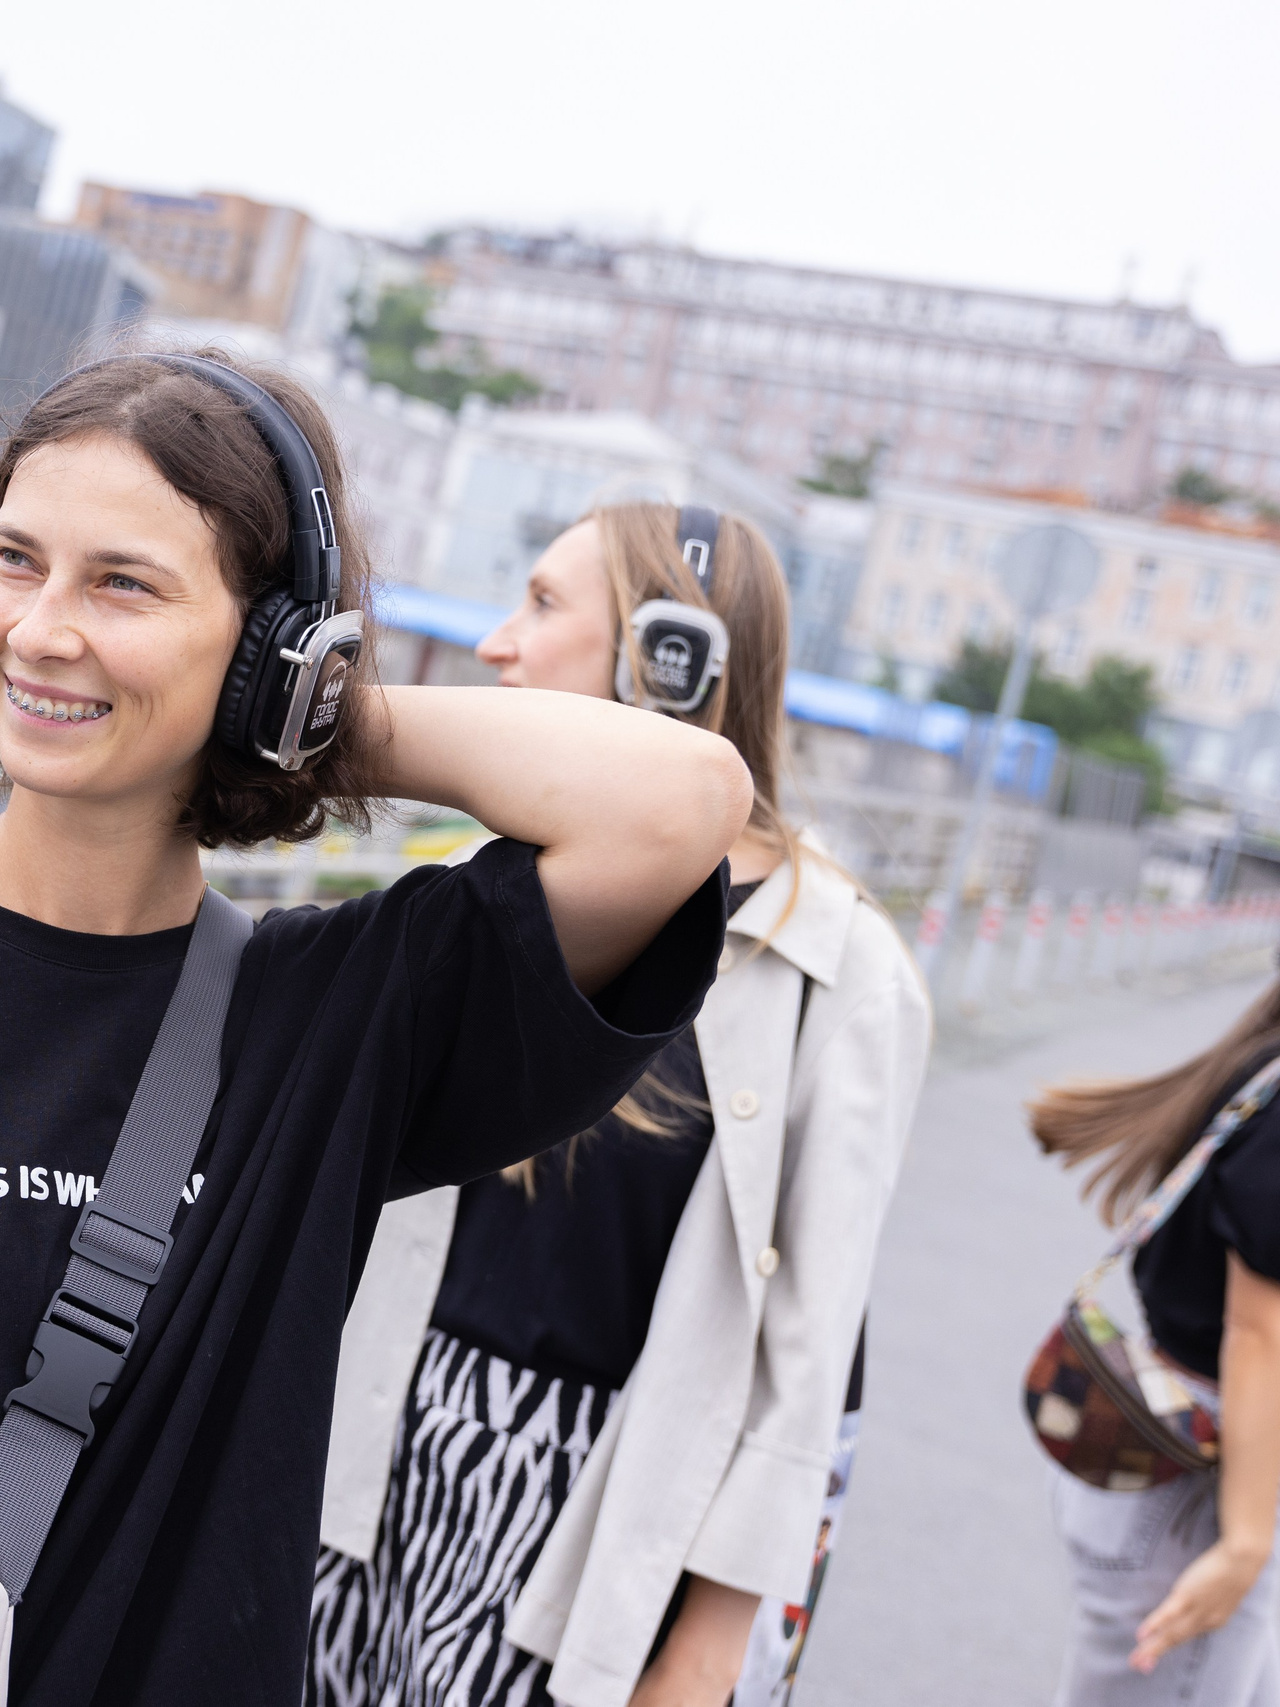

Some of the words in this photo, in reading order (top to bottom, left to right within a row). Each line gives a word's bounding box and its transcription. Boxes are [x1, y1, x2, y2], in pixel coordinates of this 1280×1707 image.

[314, 700, 340, 718] ГОЛОС
[310, 713, 336, 730] ВНУТРИ
[19, 1165, 50, 1201] IS
[53, 1170, 102, 1207] WH
